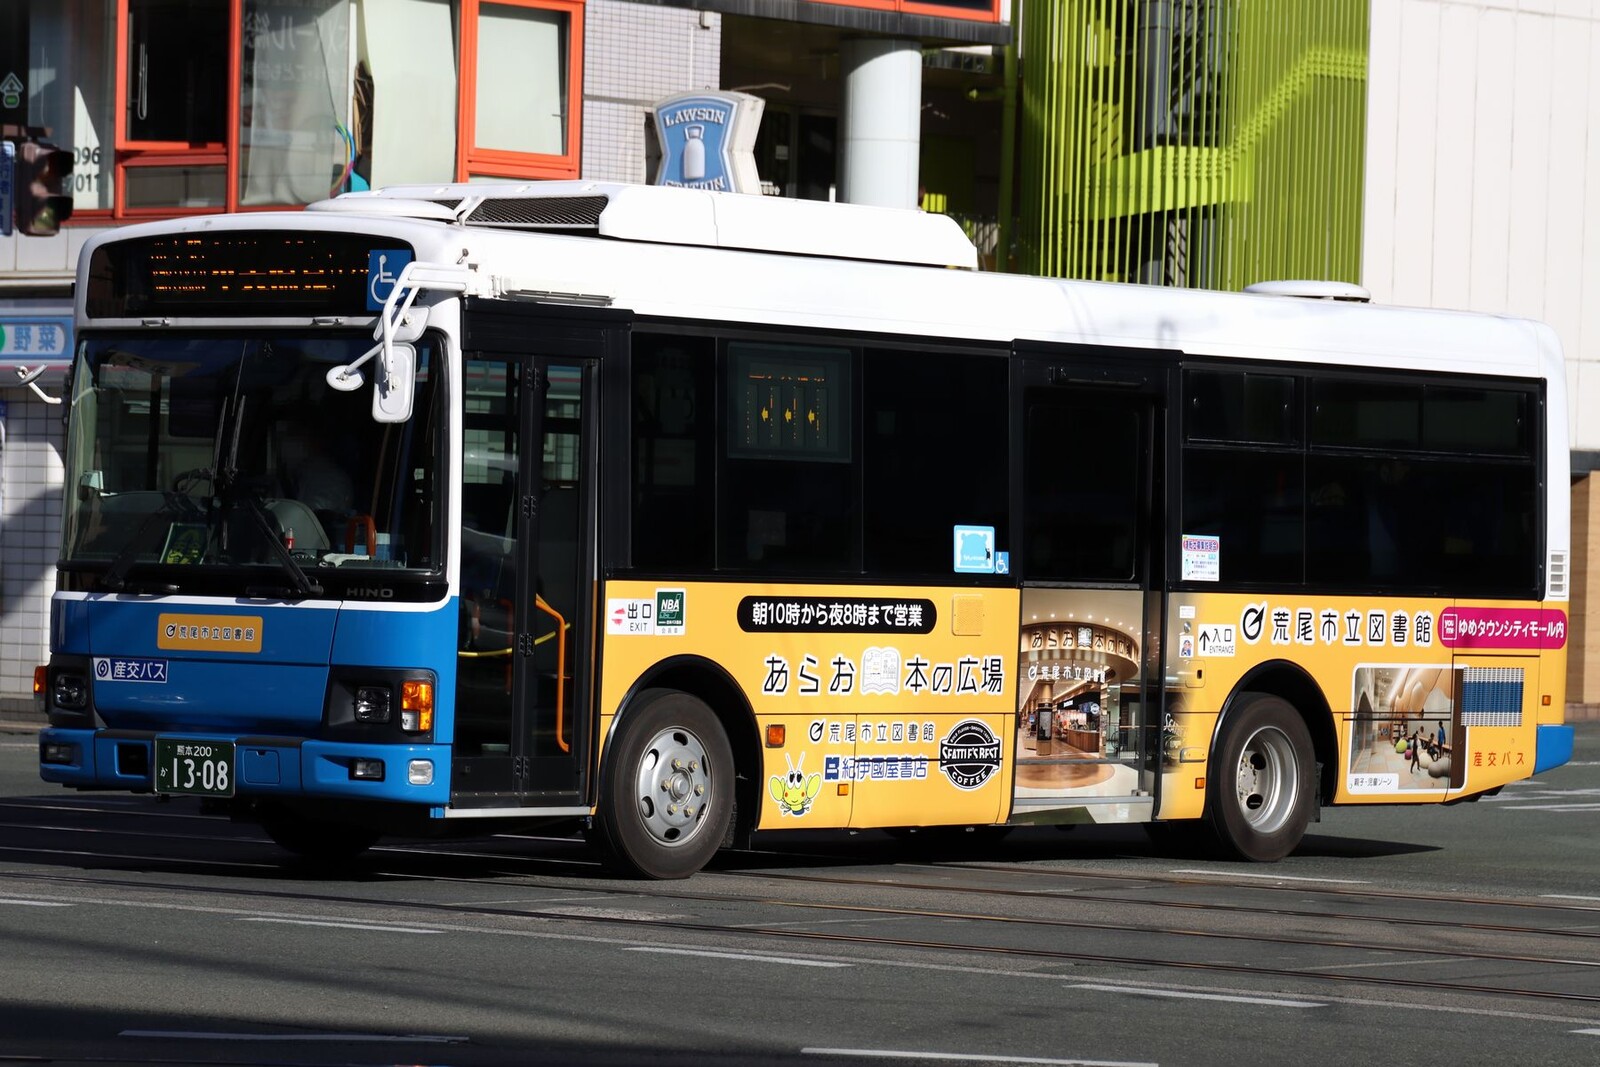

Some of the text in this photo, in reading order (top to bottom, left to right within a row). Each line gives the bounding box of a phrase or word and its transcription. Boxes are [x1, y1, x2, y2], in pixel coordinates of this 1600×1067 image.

[664, 107, 726, 128] LAWSON
[14, 325, 56, 351] 野菜
[346, 587, 394, 598] HINO
[627, 603, 652, 619] 出口
[661, 599, 680, 612] NBA
[752, 602, 923, 627] 朝10時から夜8時まで営業
[179, 626, 255, 641] 荒尾市立図書館
[629, 622, 648, 632] EXIT
[1213, 628, 1232, 643] 入口
[1273, 611, 1431, 644] 荒尾市立図書館
[1458, 619, 1564, 638] ゆめタウンシティモール内
[1032, 630, 1074, 648] あらお
[1209, 645, 1234, 655] ENTRANCE
[113, 661, 165, 680] 産交バス
[763, 656, 1003, 693] あらお 本の広場
[829, 723, 934, 742] 荒尾市立図書館
[842, 756, 928, 779] 紀伊國屋書店
[1473, 751, 1525, 767] 産交バス
[160, 766, 168, 777] か
[173, 757, 228, 790] 13-08
[952, 770, 987, 786] COFFEE
